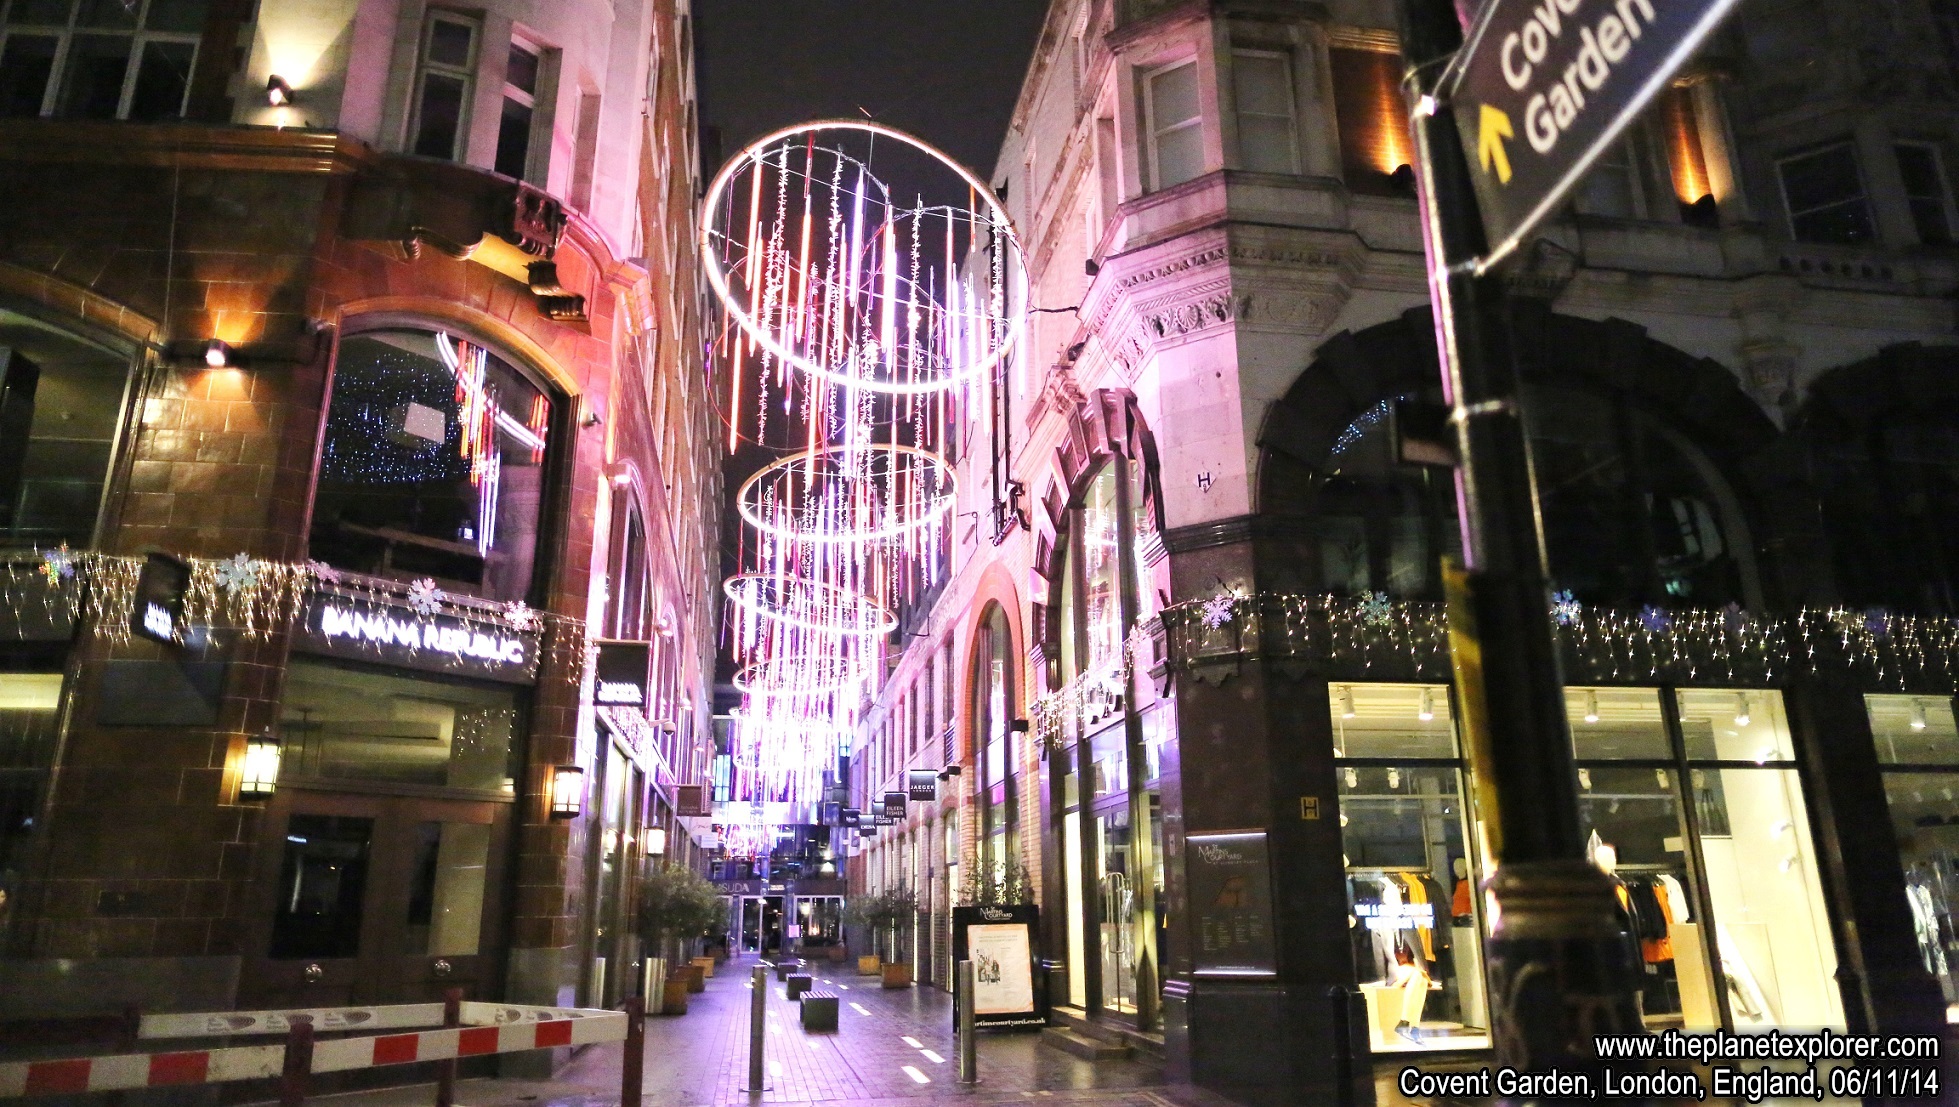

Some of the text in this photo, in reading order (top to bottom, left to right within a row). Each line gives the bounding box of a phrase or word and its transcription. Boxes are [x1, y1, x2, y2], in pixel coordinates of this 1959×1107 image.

[1525, 0, 1656, 153] Garden
[321, 605, 524, 663] BANANA REPUBLIC
